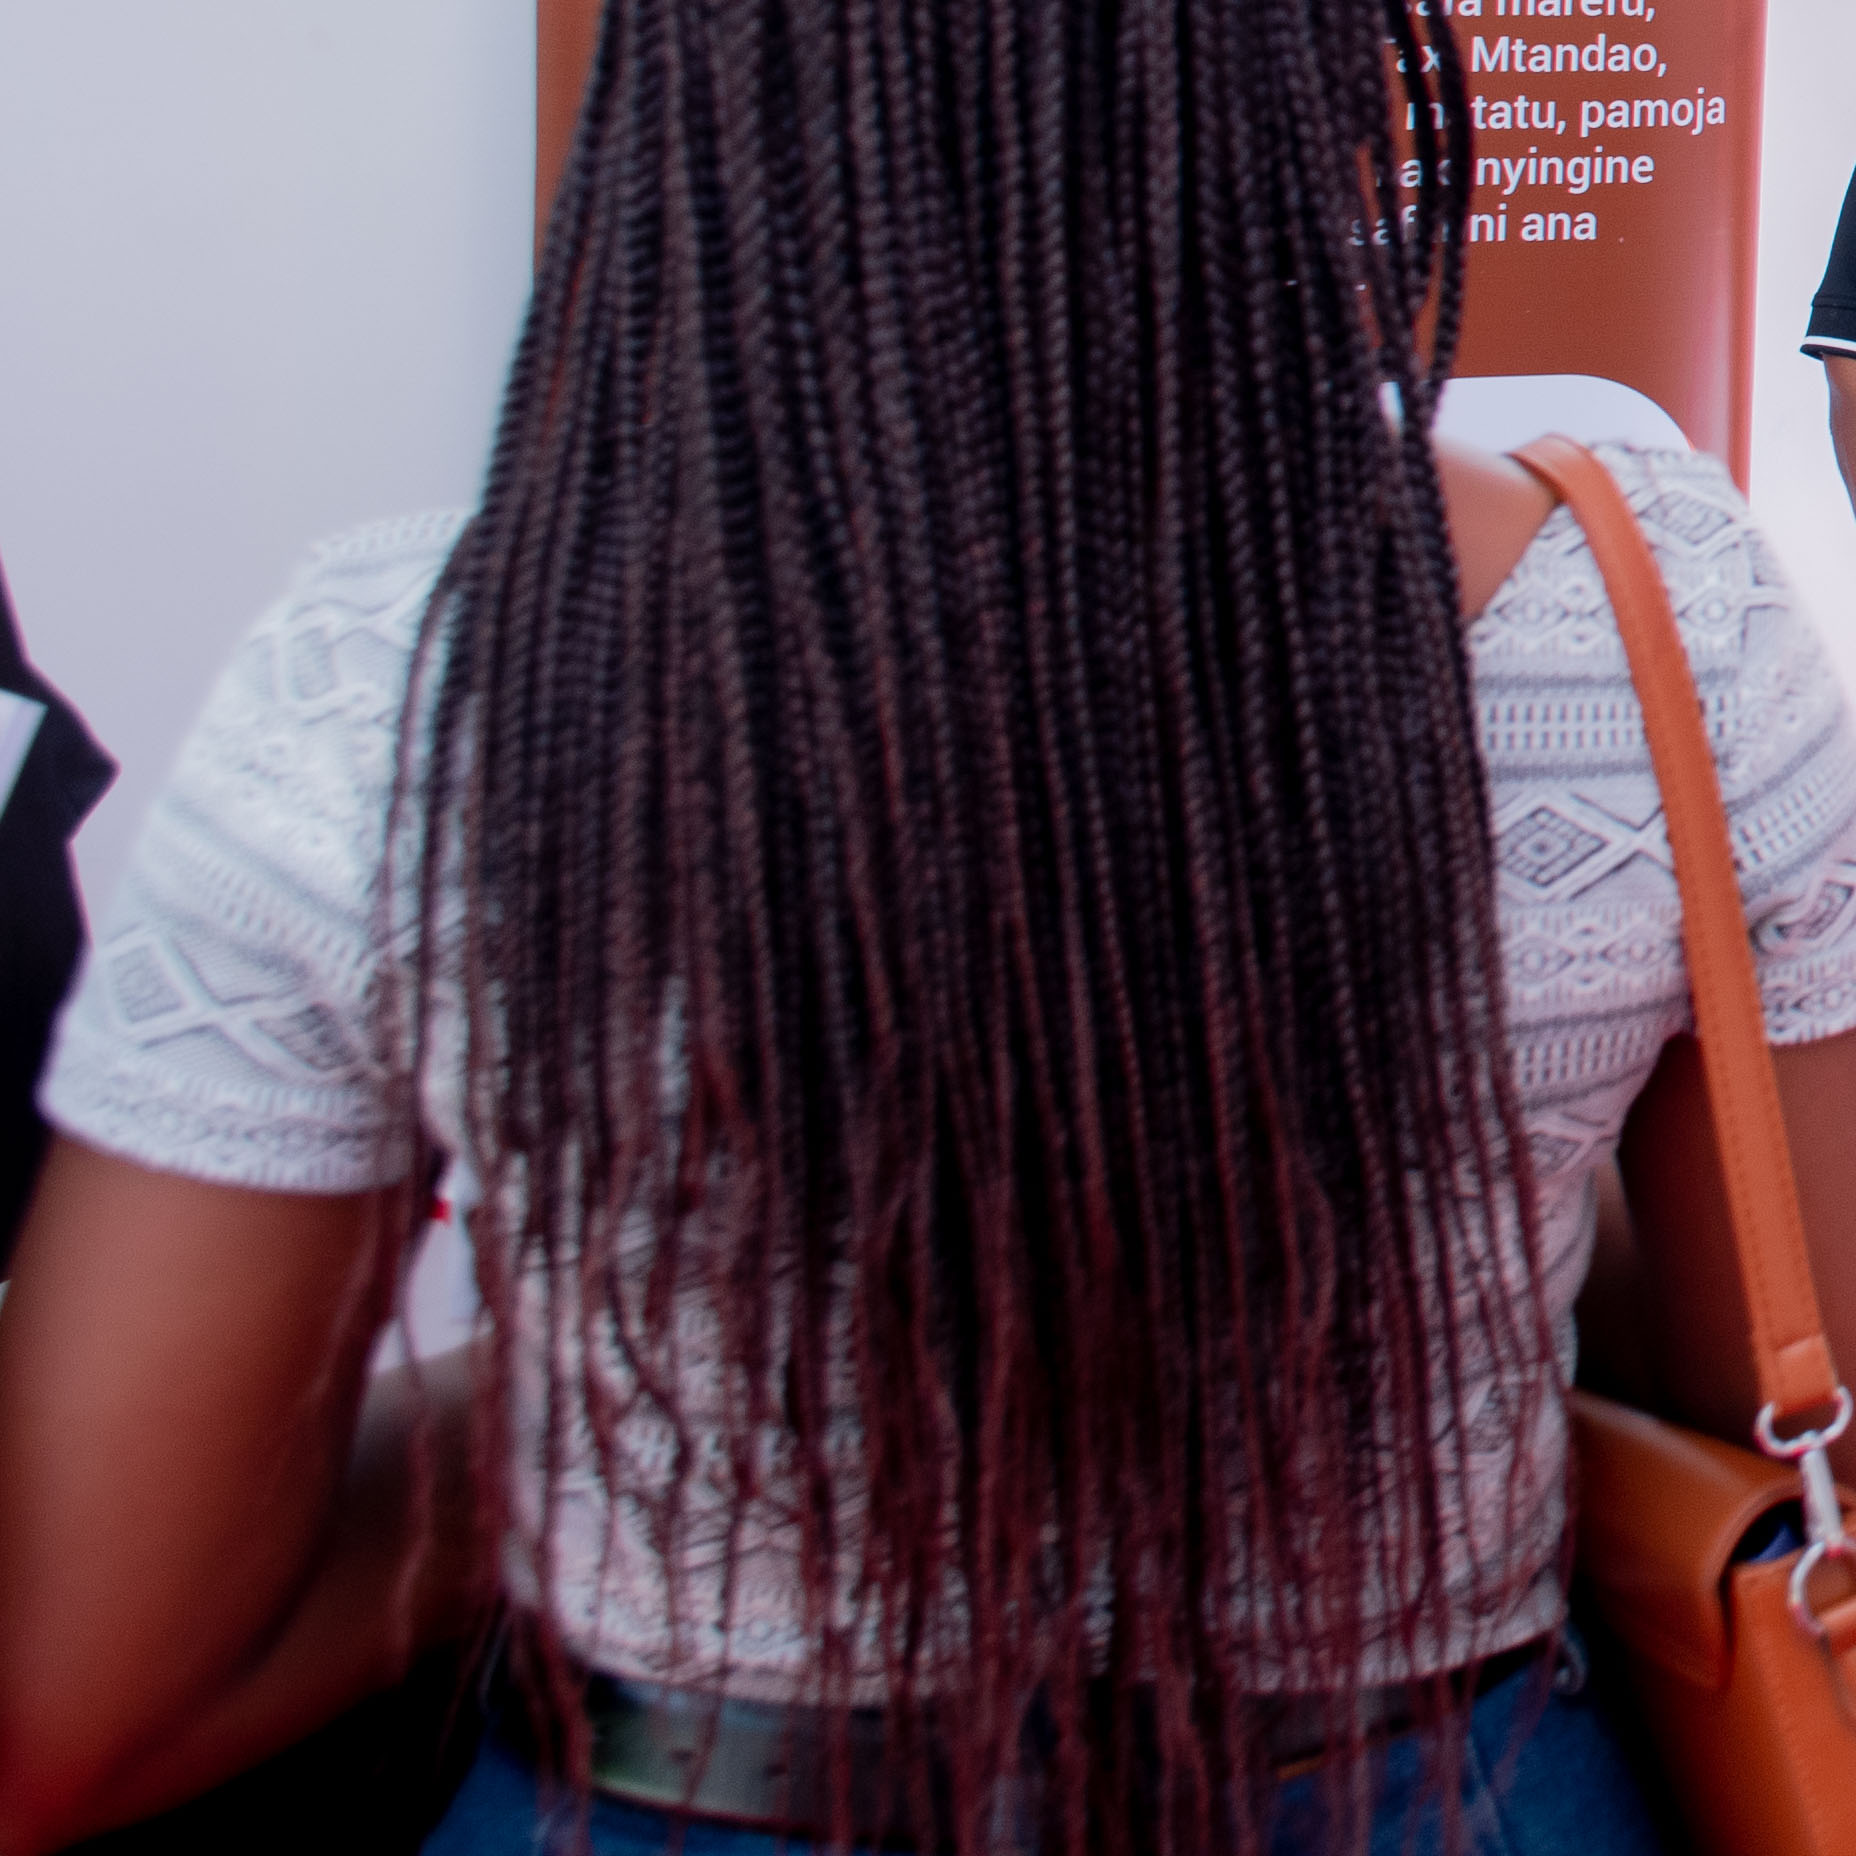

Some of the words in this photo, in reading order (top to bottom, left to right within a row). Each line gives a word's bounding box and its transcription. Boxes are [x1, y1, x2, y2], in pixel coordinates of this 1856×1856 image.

[1471, 33, 1667, 77] Mtandao,
[1580, 87, 1726, 138] pamoja
[1476, 146, 1655, 195] nyingine
[1521, 210, 1597, 241] ana
